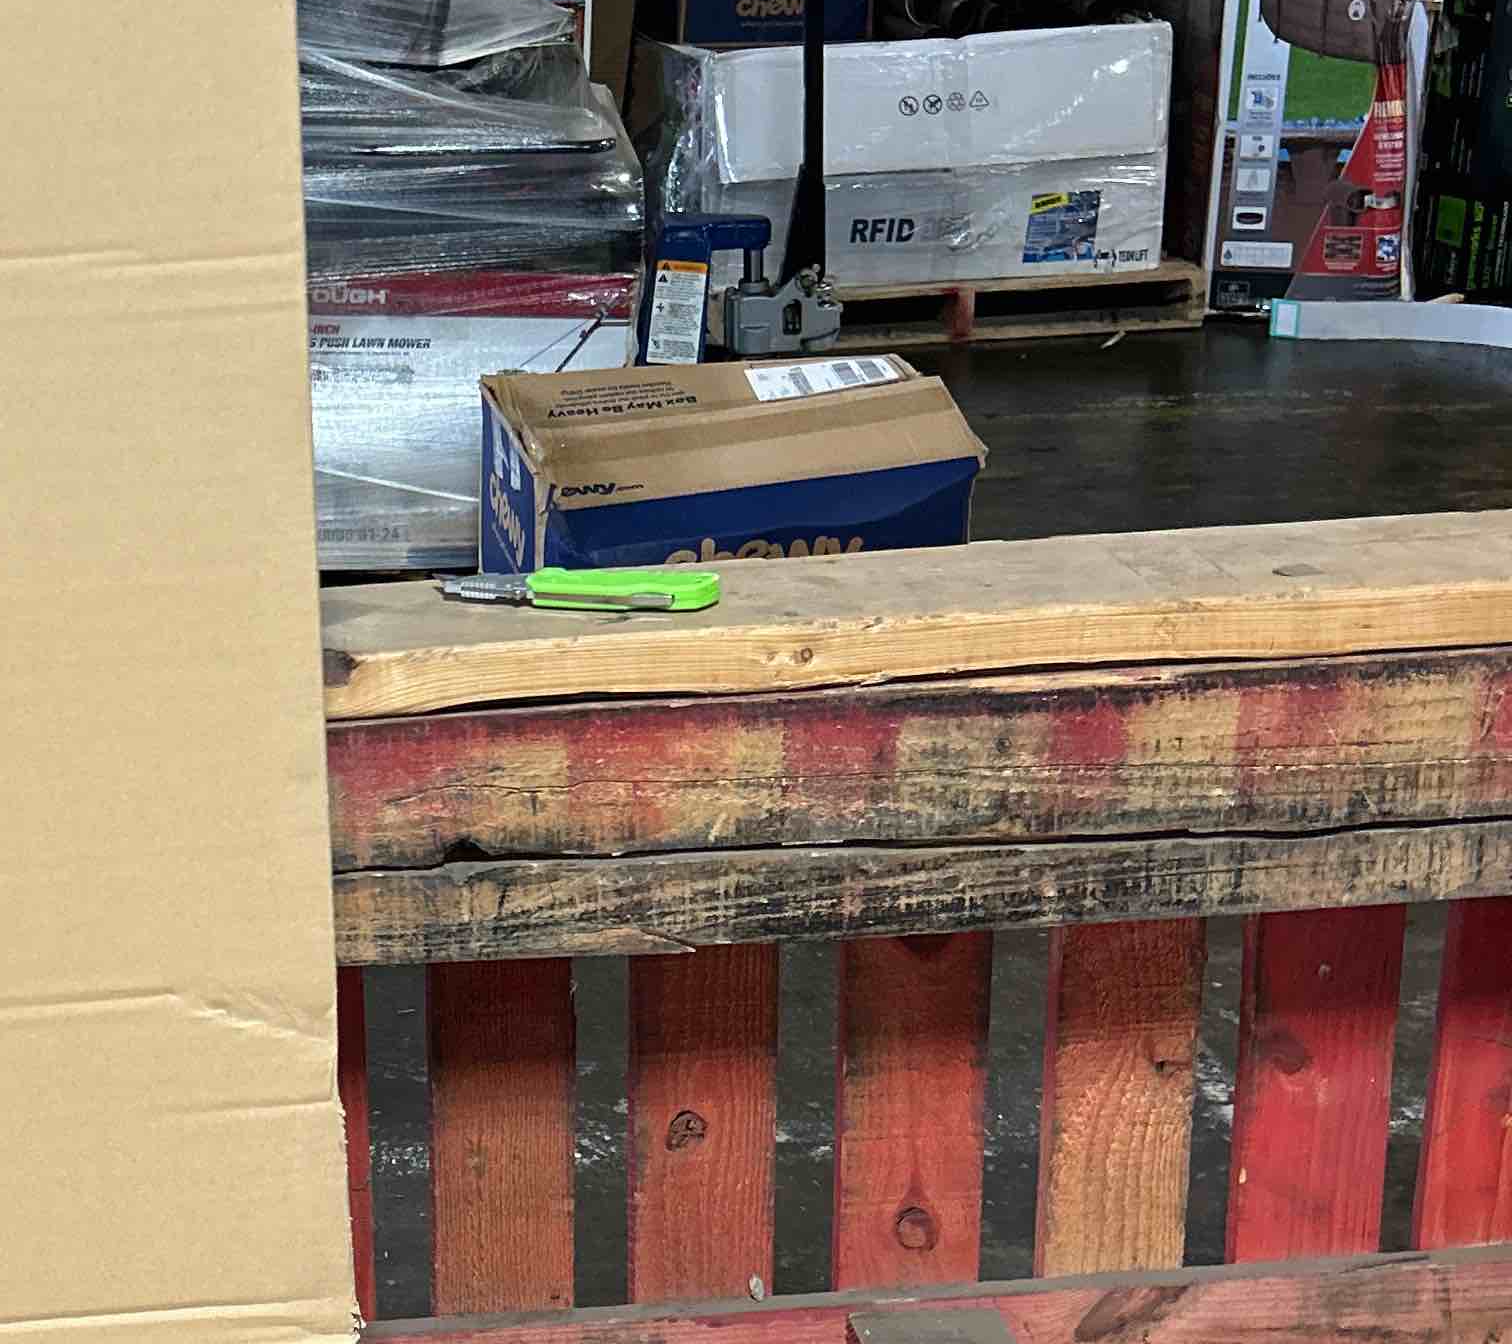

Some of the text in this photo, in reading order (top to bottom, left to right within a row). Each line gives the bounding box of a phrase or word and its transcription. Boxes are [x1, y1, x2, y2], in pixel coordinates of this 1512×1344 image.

[850, 219, 914, 243] RFID
[319, 337, 350, 349] PUSH
[351, 337, 385, 349] LAWN
[387, 338, 432, 349] MOWER
